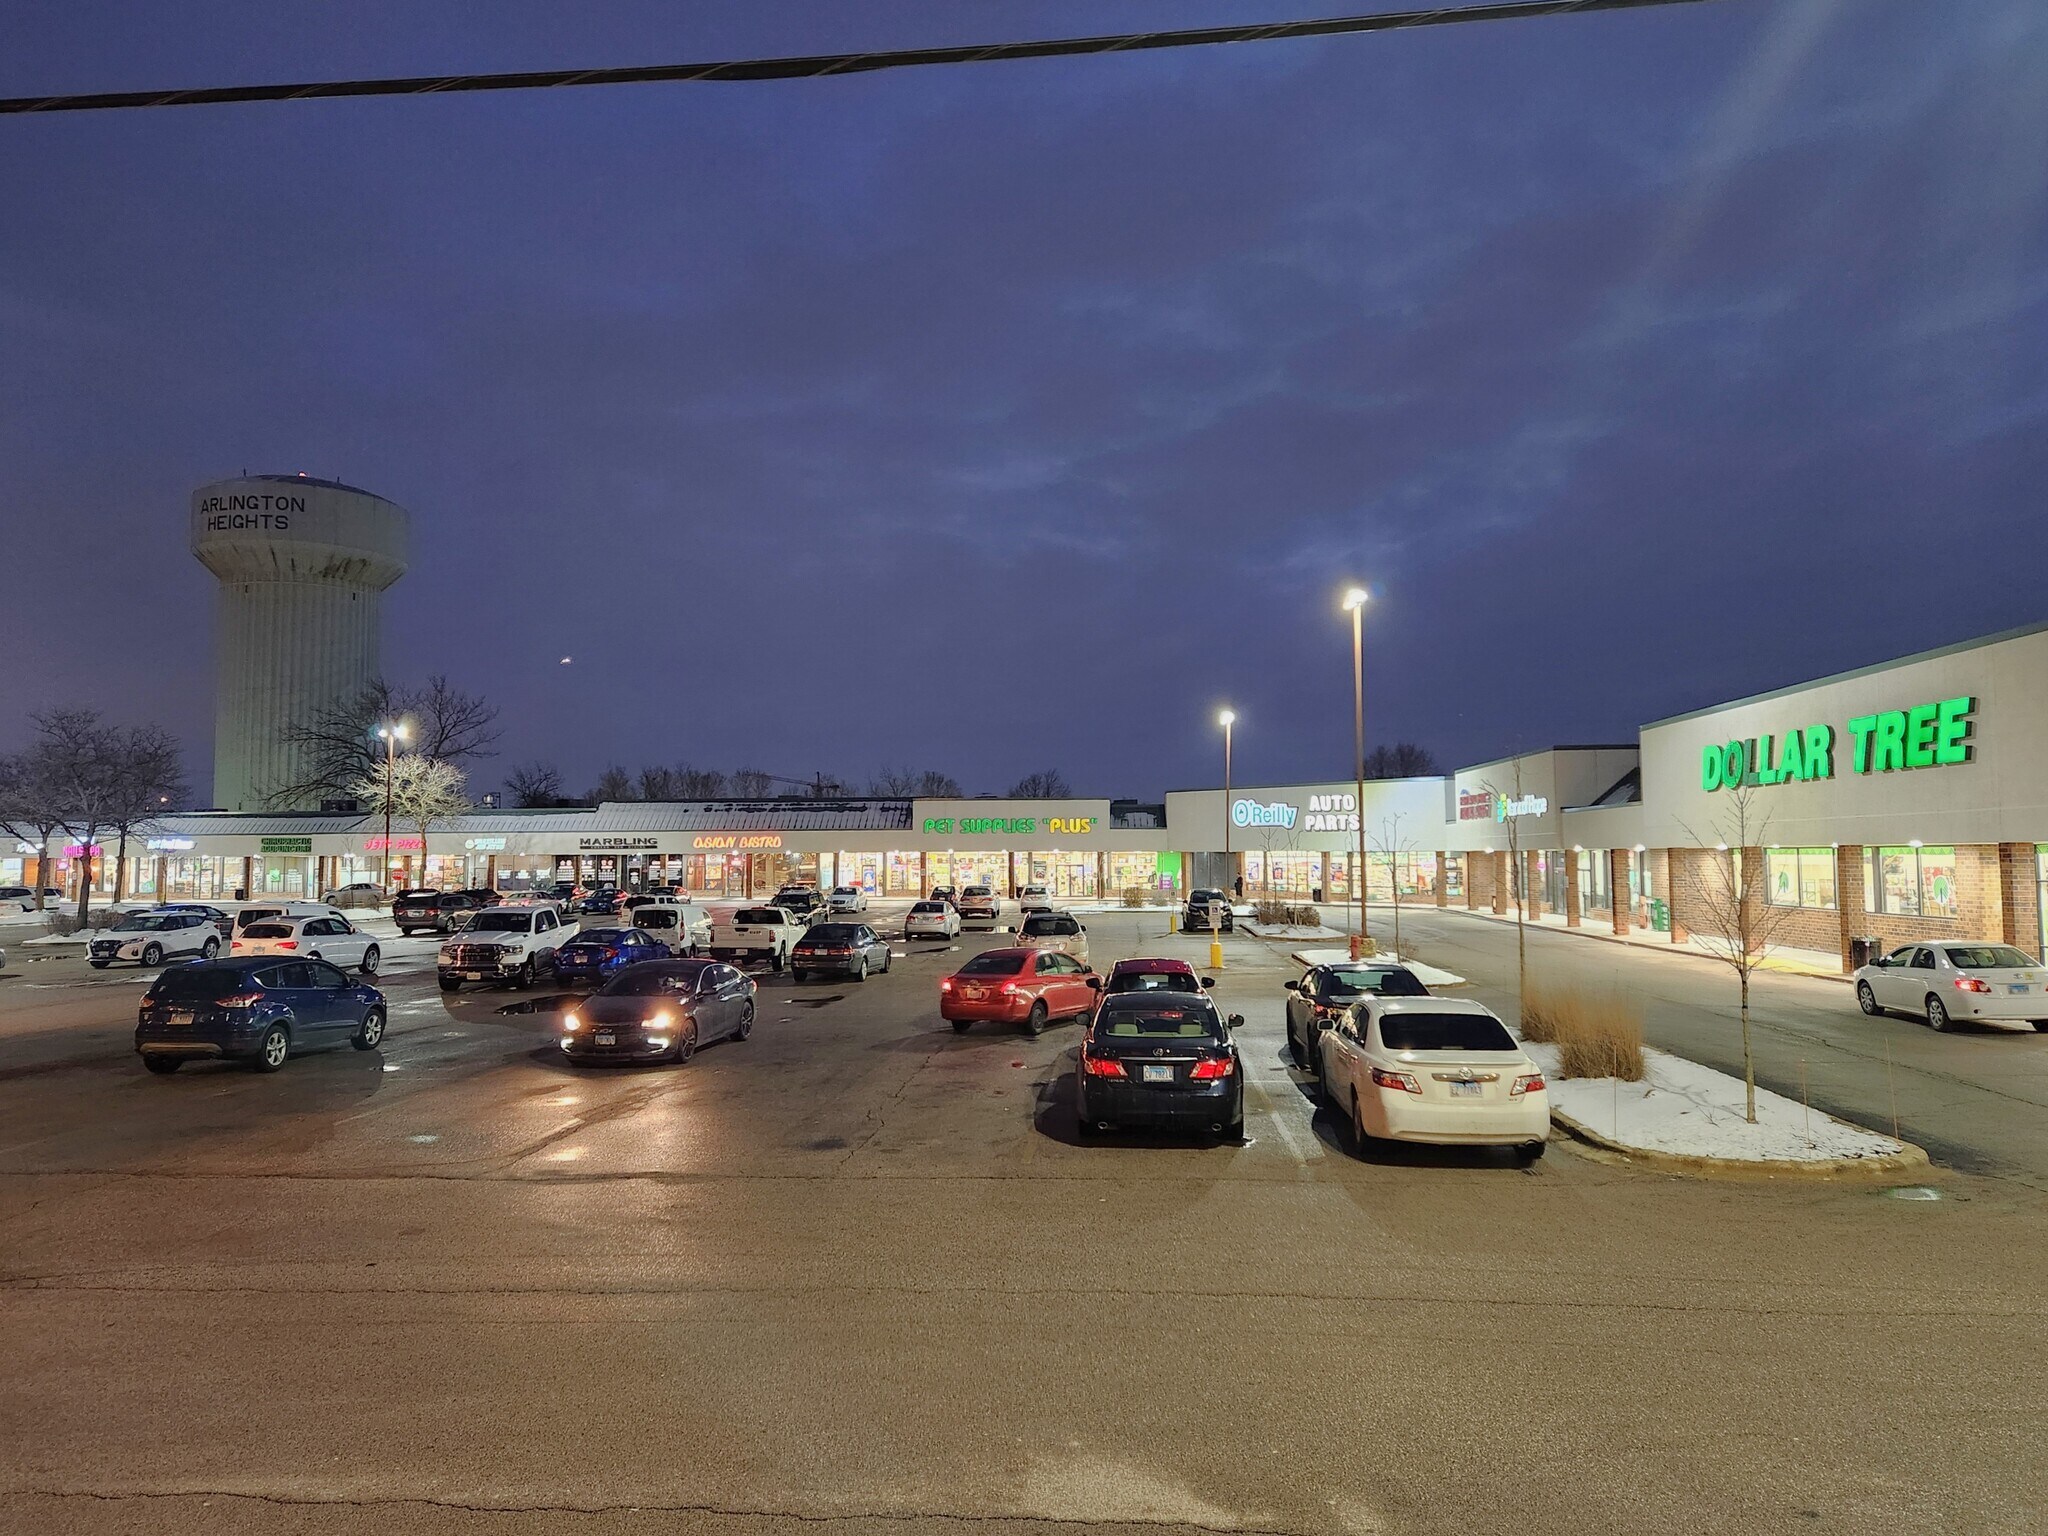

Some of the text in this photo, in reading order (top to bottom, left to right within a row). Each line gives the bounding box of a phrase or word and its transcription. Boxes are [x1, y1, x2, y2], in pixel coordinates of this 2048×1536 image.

[200, 495, 305, 514] ARLINGTON
[207, 514, 289, 532] HEIGHTS
[1701, 696, 1975, 792] DOLLAR TREE
[1308, 795, 1356, 813] AUTO
[1233, 800, 1296, 828] O'Reilly
[1304, 814, 1360, 832] PARTS
[923, 817, 955, 834] PET
[960, 818, 1036, 834] SUPPLIES
[579, 837, 658, 846] MARBLING
[738, 836, 782, 849] BISTRO
